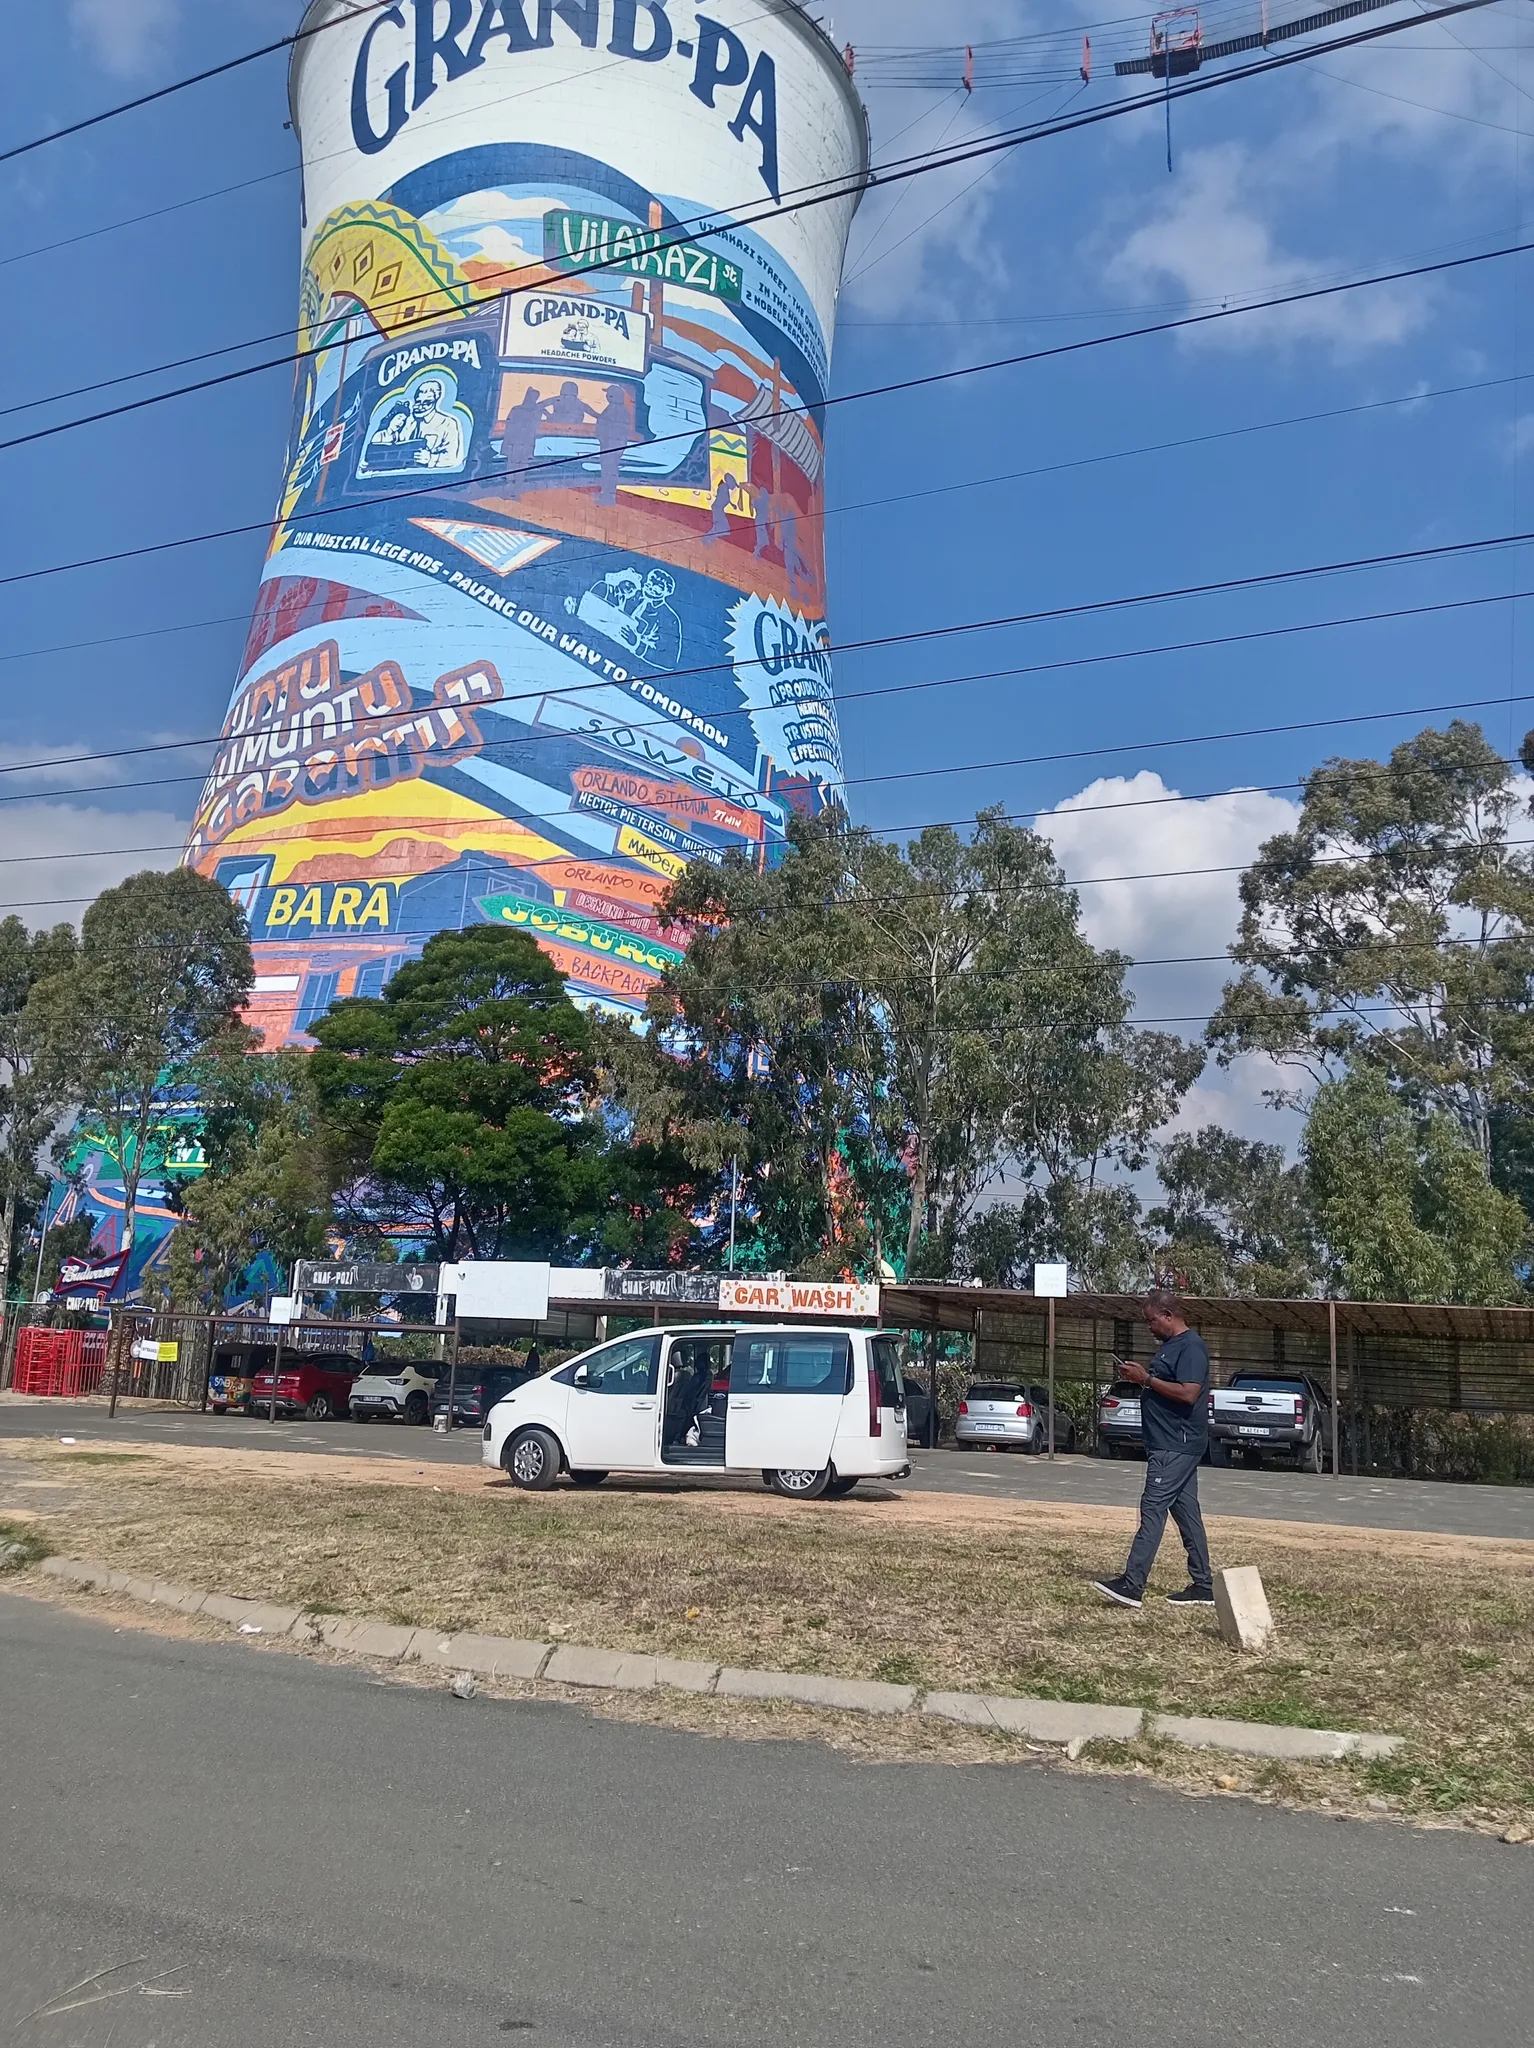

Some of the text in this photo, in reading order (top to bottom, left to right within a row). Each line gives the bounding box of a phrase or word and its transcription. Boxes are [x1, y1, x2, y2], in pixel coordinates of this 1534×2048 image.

[757, 255, 789, 293] STREET
[792, 297, 805, 318] THE
[524, 298, 630, 341] GRAND-PA
[746, 290, 752, 301] 2
[754, 294, 782, 324] NOBEL
[782, 319, 805, 349] PEACE
[759, 282, 771, 298] IN
[772, 292, 788, 314] THE
[787, 310, 810, 344] WORLD
[377, 339, 482, 387] GRAND-PA
[541, 348, 617, 365] HEADACHE POWDERS
[293, 531, 311, 546] OUR
[313, 532, 371, 551] MUSICAL
[370, 540, 444, 574] LEGENDS
[448, 571, 516, 618] PAVING
[517, 610, 558, 642] OUR
[558, 633, 602, 666] WAY
[603, 658, 628, 682] TO
[630, 673, 729, 748] TOMORROW
[578, 719, 758, 808] SOWETO
[582, 771, 648, 800] ORLANDO
[655, 789, 711, 818] STADIUM
[579, 791, 723, 867] HECTOR PIETERSON MUSEUM
[564, 867, 634, 888] ORLANDO
[265, 887, 389, 926] BARA
[575, 892, 624, 920] DESMOND
[502, 901, 677, 970] JOBURG
[735, 1287, 852, 1309] CAR WASH
